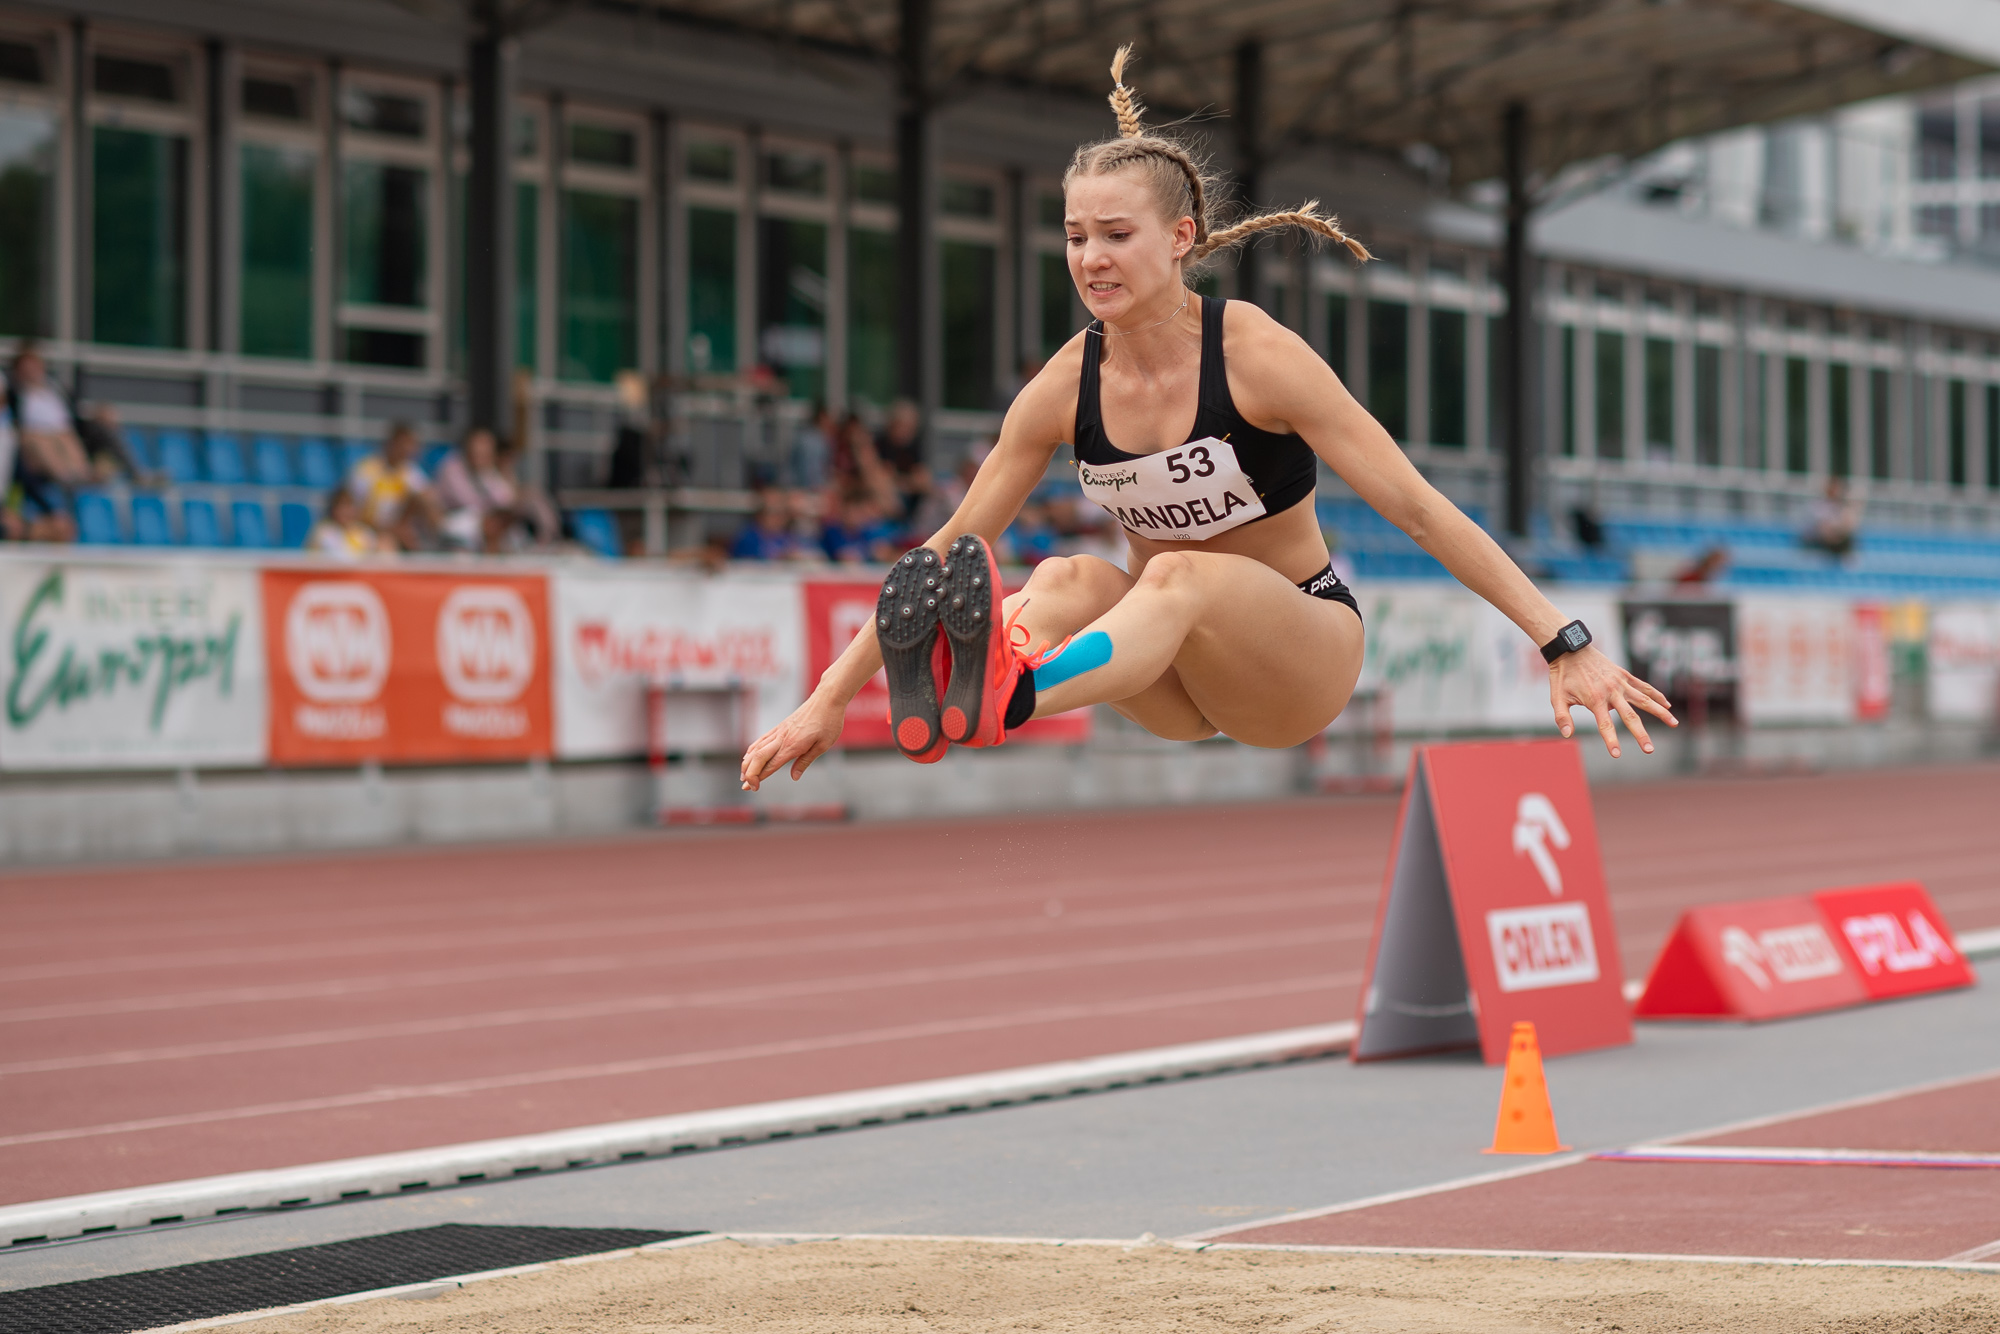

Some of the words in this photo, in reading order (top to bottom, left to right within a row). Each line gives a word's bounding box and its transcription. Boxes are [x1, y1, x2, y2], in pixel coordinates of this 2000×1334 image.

[1082, 467, 1138, 492] Europol
[1166, 446, 1216, 484] 53
[1102, 491, 1248, 530] MANDELA
[1310, 570, 1337, 595] PRO
[6, 566, 242, 734] Europol
[1570, 627, 1584, 644] 13:52
[1501, 917, 1588, 974] ORLEN
